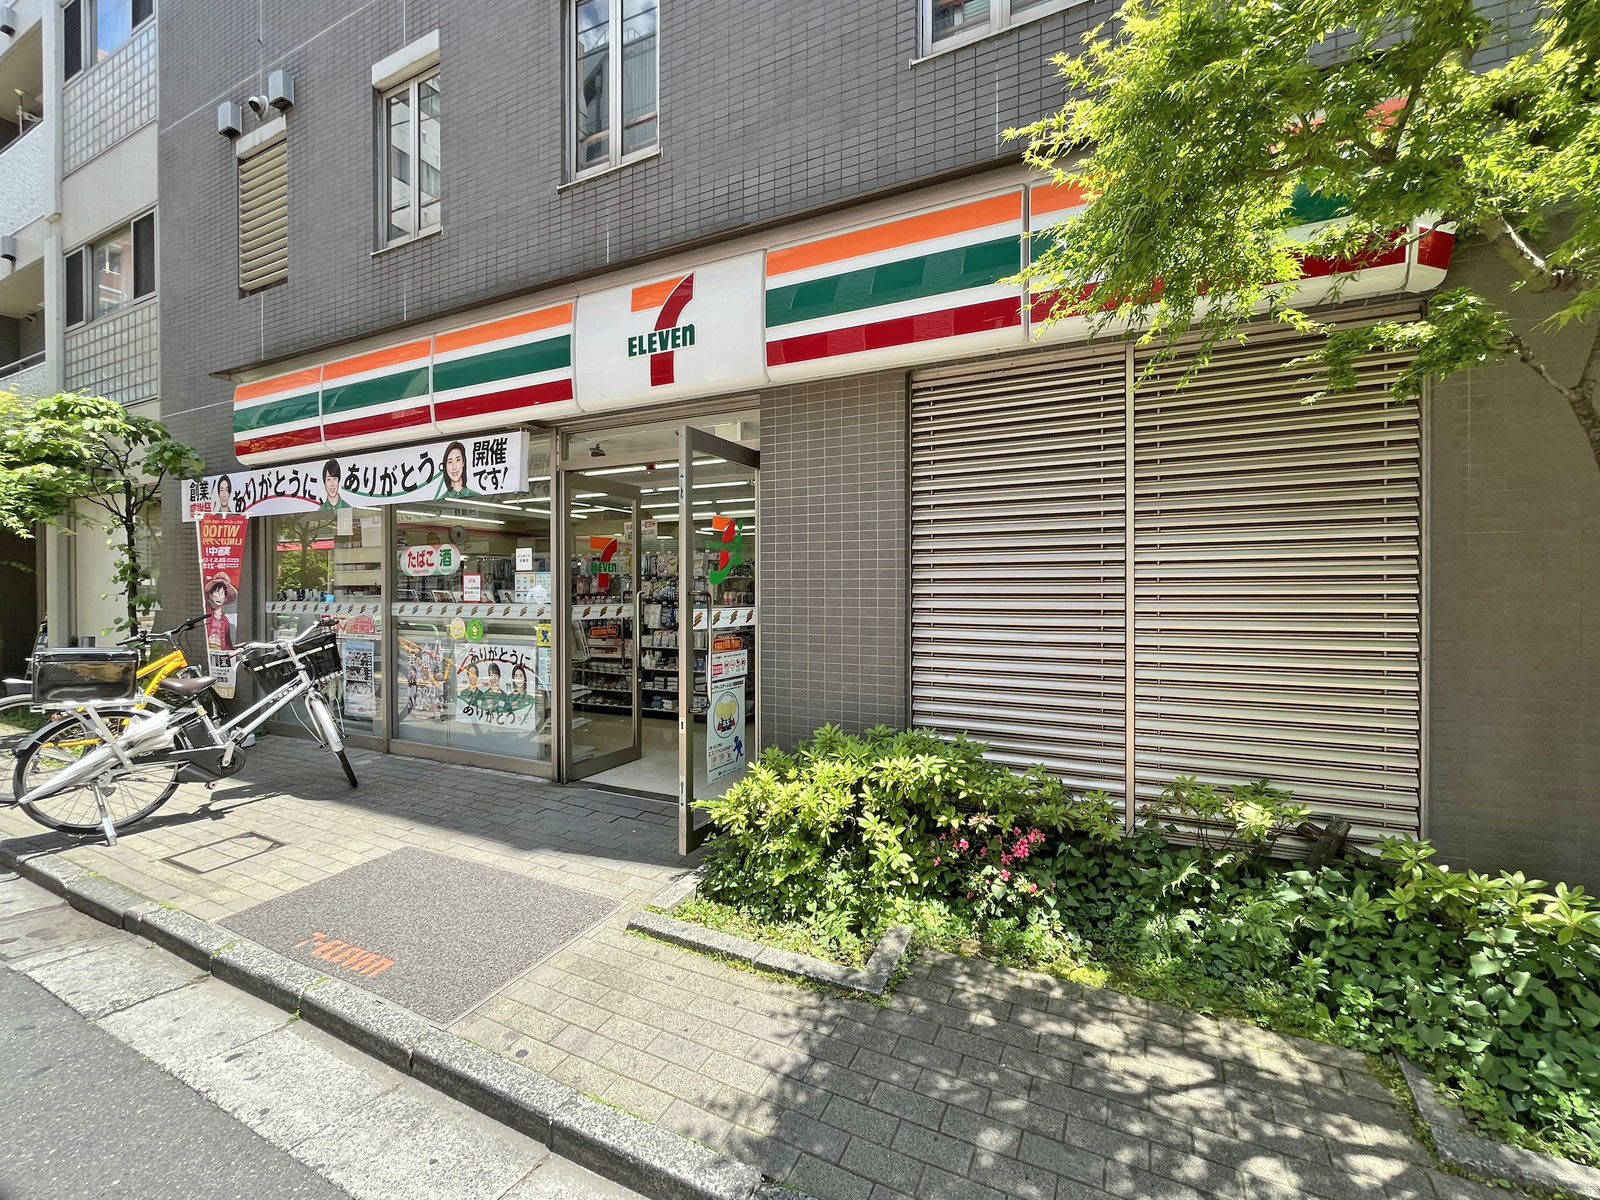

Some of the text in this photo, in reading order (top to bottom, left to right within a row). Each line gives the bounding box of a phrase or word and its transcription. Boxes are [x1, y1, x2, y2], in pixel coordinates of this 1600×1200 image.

[631, 272, 695, 387] 7
[472, 437, 508, 468] 開催
[473, 466, 509, 491] です!
[407, 550, 435, 569] たばこ
[439, 548, 452, 567] 酒
